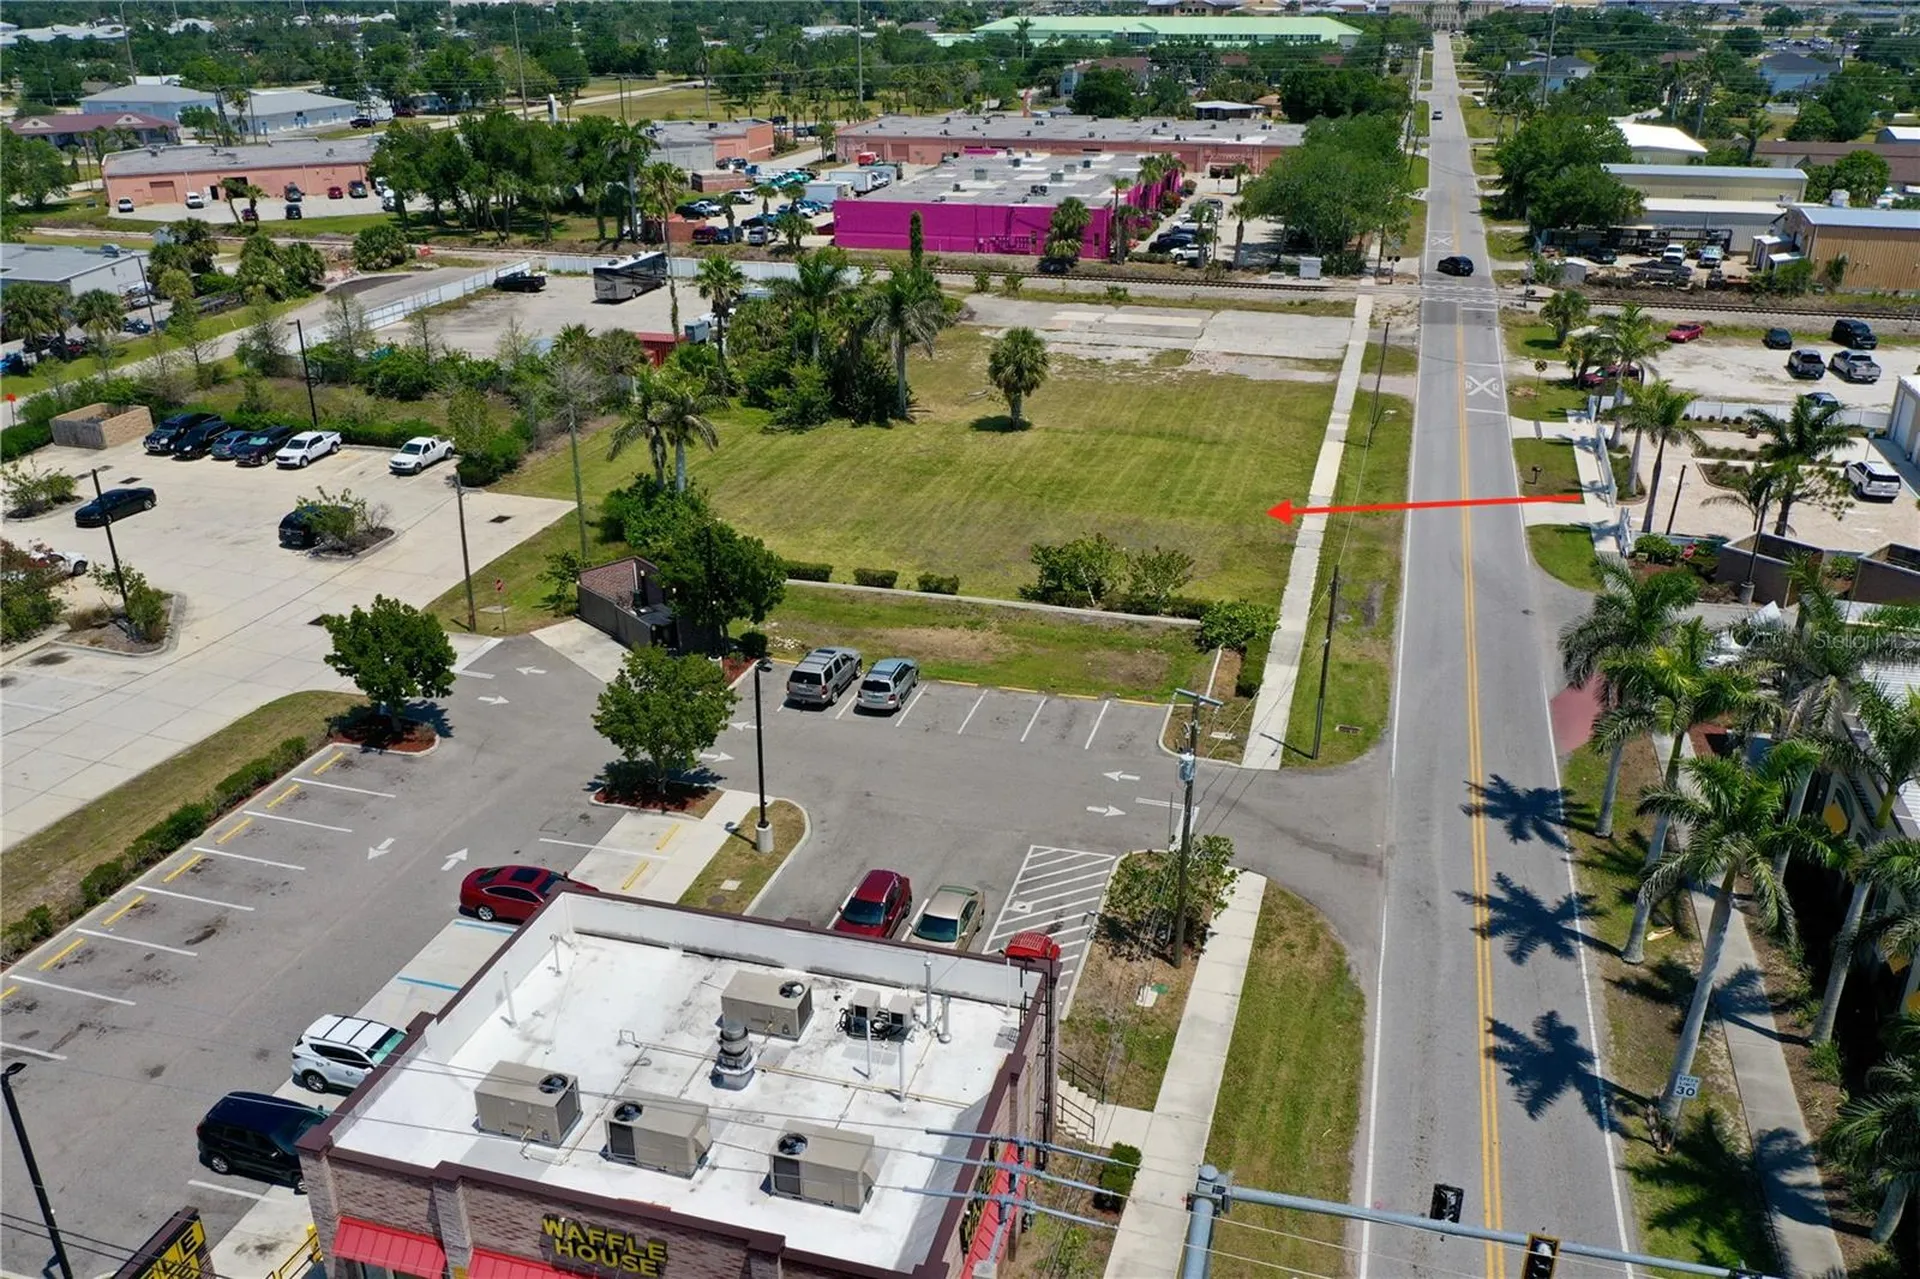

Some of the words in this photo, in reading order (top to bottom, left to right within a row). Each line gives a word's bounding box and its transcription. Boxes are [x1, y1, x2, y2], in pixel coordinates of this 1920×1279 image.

[1676, 1085, 1696, 1096] 30
[541, 1217, 667, 1263] WAFFLE
[554, 1238, 659, 1278] HOUSE
